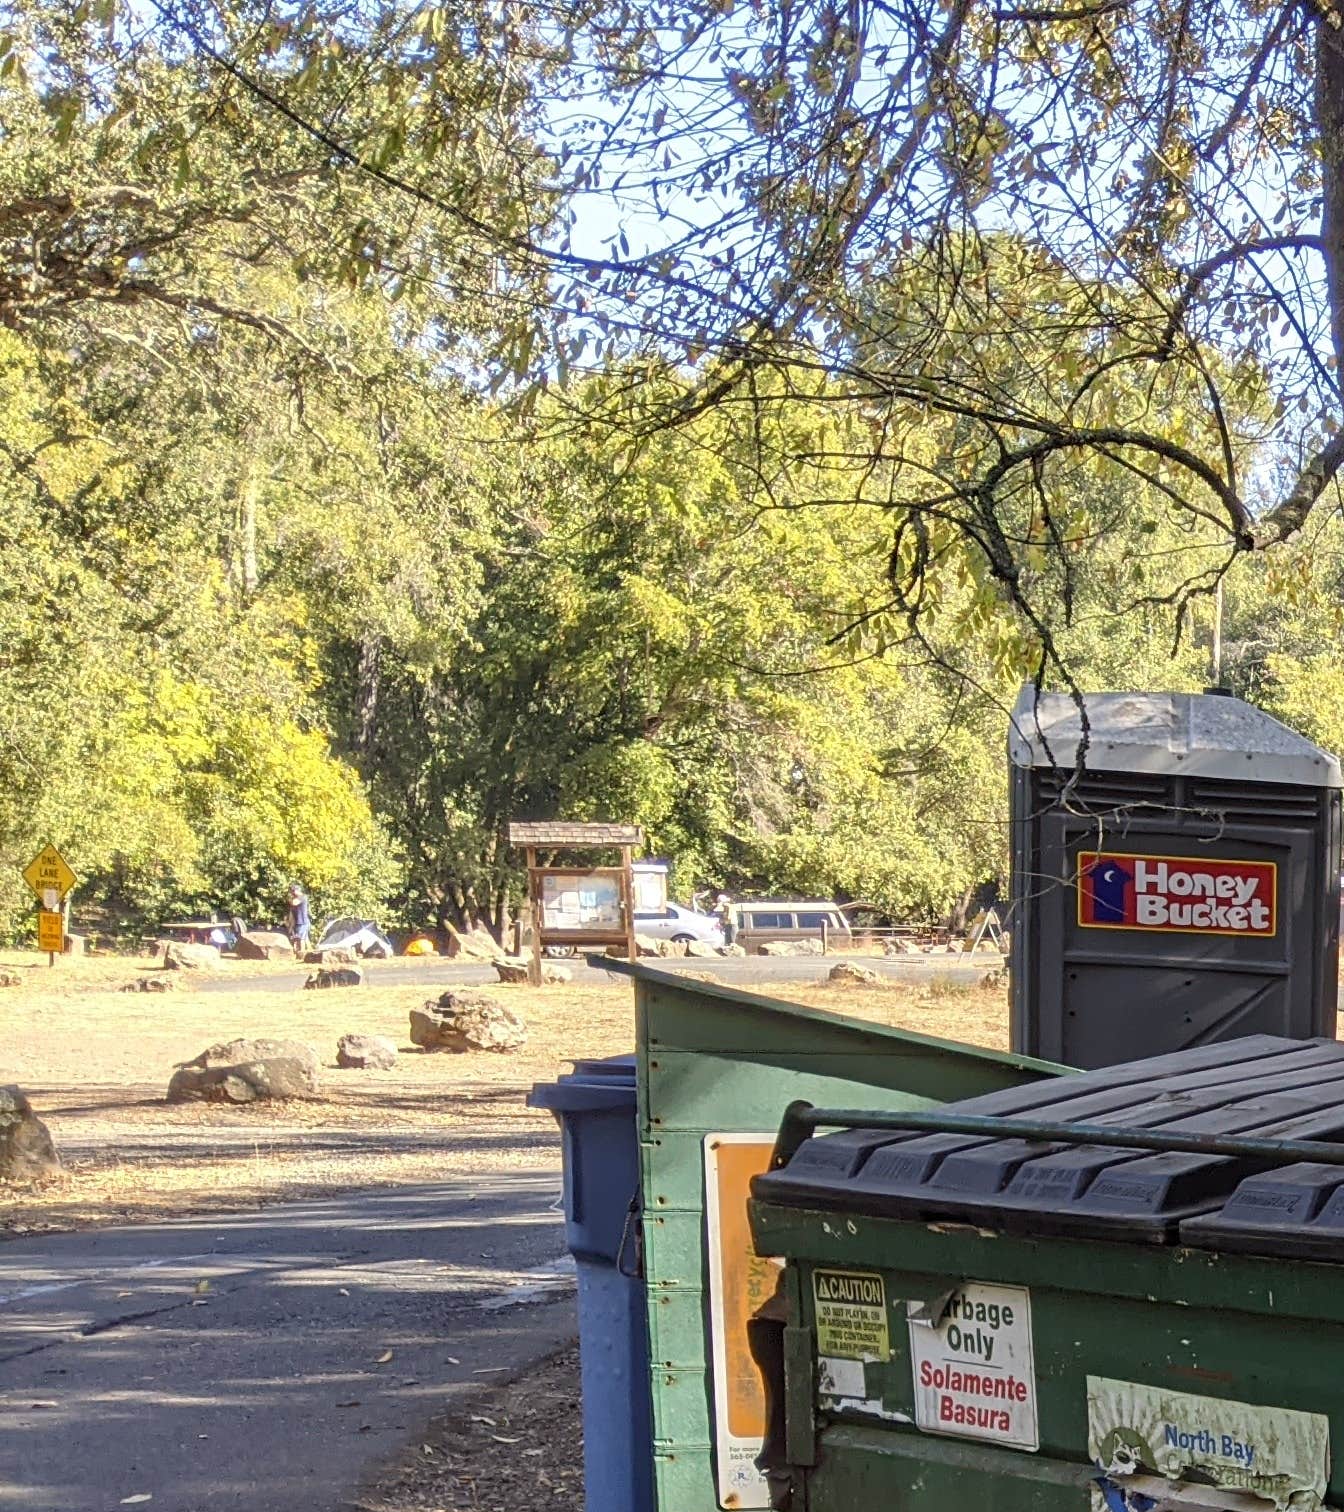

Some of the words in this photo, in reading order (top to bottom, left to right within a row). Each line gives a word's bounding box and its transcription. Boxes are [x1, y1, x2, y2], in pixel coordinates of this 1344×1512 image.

[39, 867, 60, 879] LANE
[41, 855, 57, 866] ONE
[35, 879, 63, 891] BRIDGE
[1135, 860, 1259, 905] Honey
[1136, 894, 1270, 930] Bucket
[829, 1276, 881, 1303] CAUTION
[947, 1324, 994, 1361] Only
[920, 1360, 1028, 1402] Solamente
[940, 1395, 1010, 1432] Basura
[1164, 1424, 1217, 1455] North
[1222, 1434, 1255, 1468] Bay
